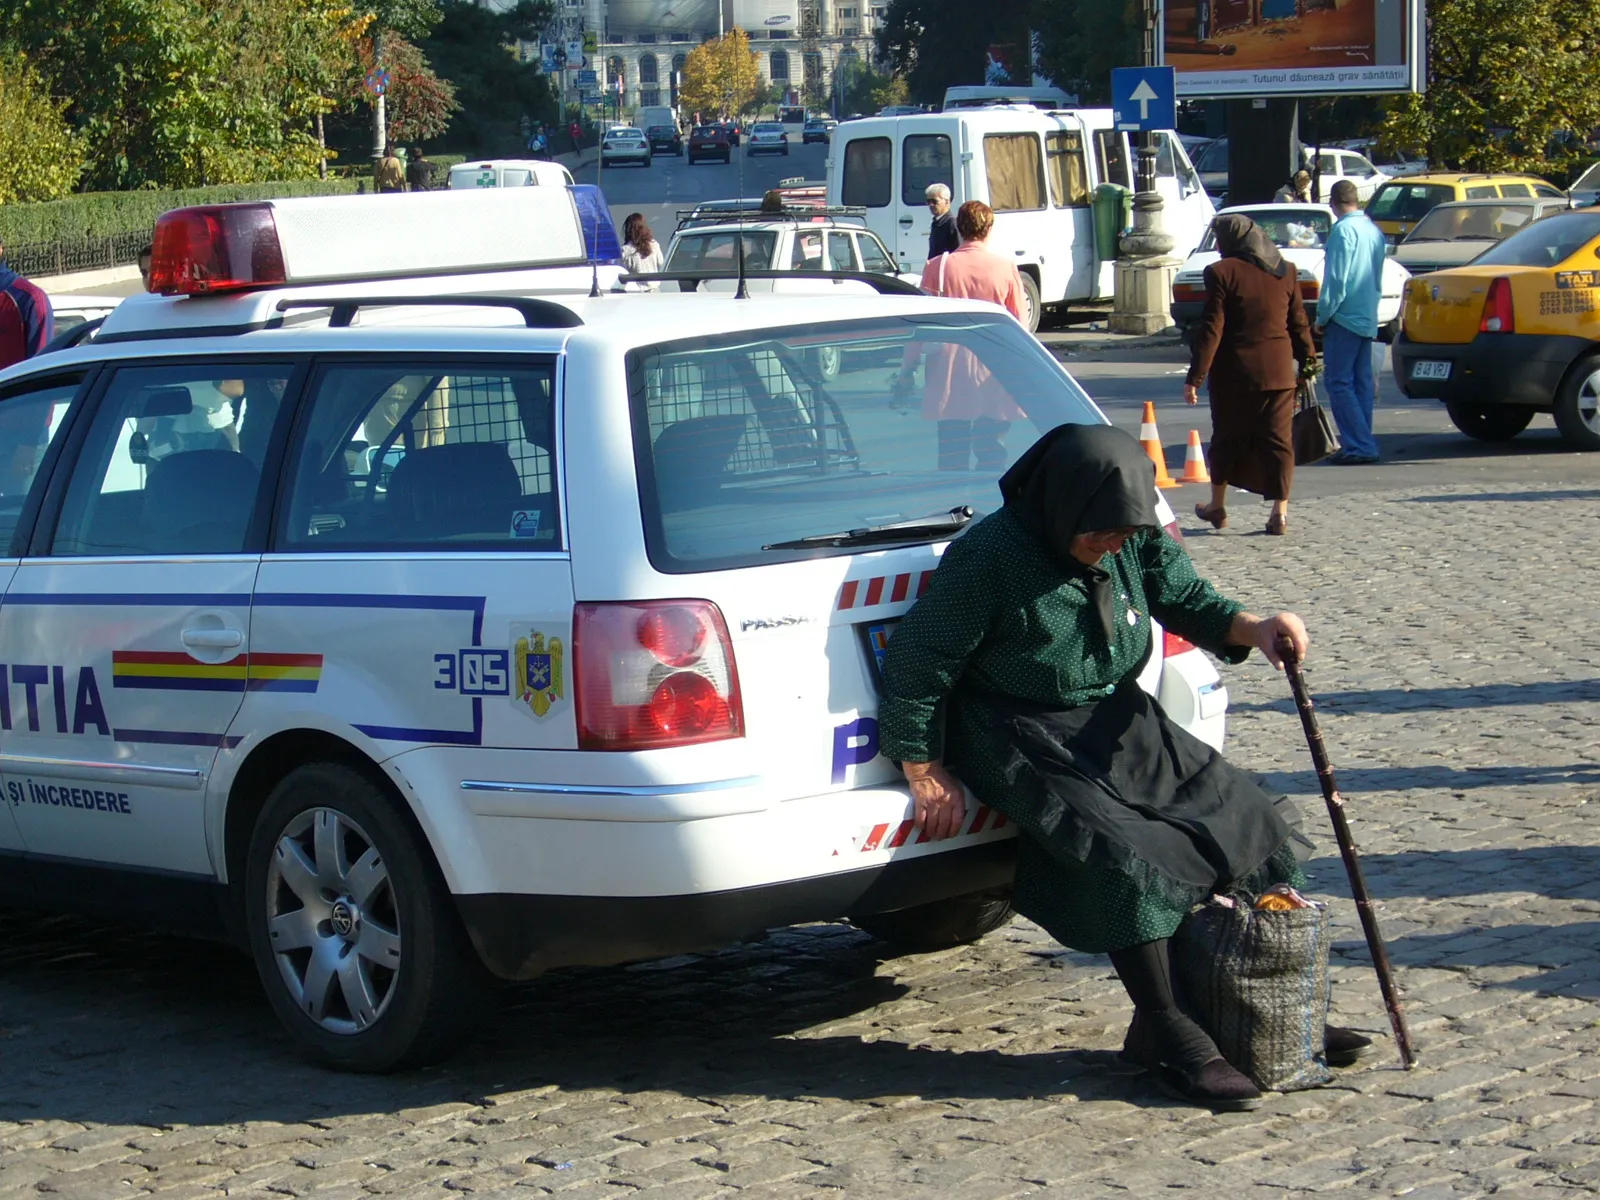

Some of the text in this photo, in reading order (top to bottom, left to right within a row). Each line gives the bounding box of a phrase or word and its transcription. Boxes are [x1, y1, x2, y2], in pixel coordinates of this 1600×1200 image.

[1252, 74, 1287, 84] Tutunul
[1290, 72, 1335, 83] dăunează
[1338, 72, 1359, 82] grav
[1566, 273, 1593, 285] TAXI
[740, 615, 817, 632] PASSA
[433, 652, 507, 691] 305
[0, 664, 111, 735] ITIA
[27, 779, 132, 814] ÎNCREDERE
